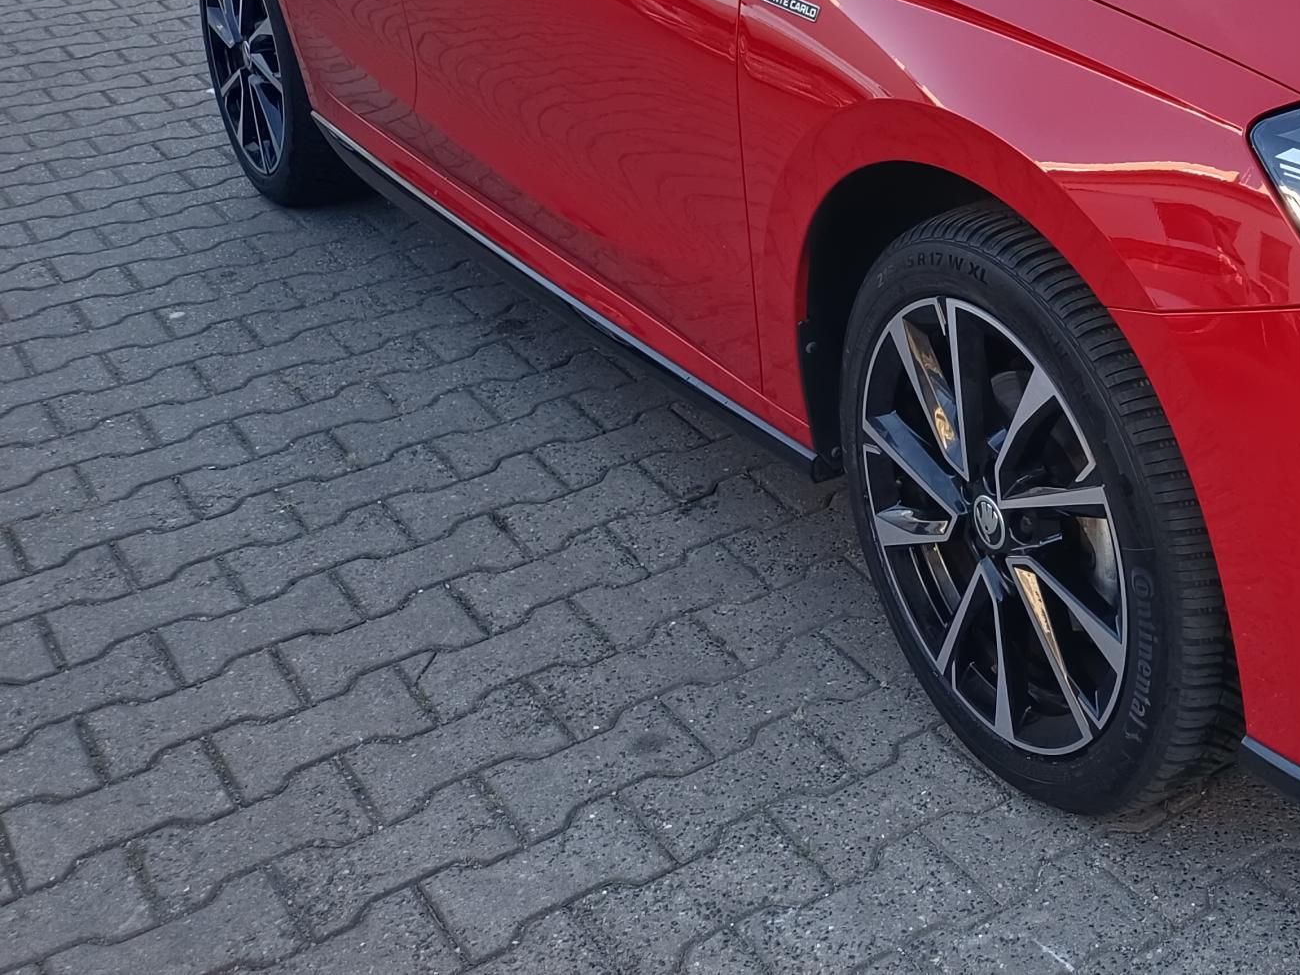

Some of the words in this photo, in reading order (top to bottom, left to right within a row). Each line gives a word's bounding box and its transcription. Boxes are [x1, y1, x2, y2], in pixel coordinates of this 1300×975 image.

[789, 0, 817, 18] CARLO
[967, 261, 988, 285] XL
[1129, 567, 1159, 729] Continental
